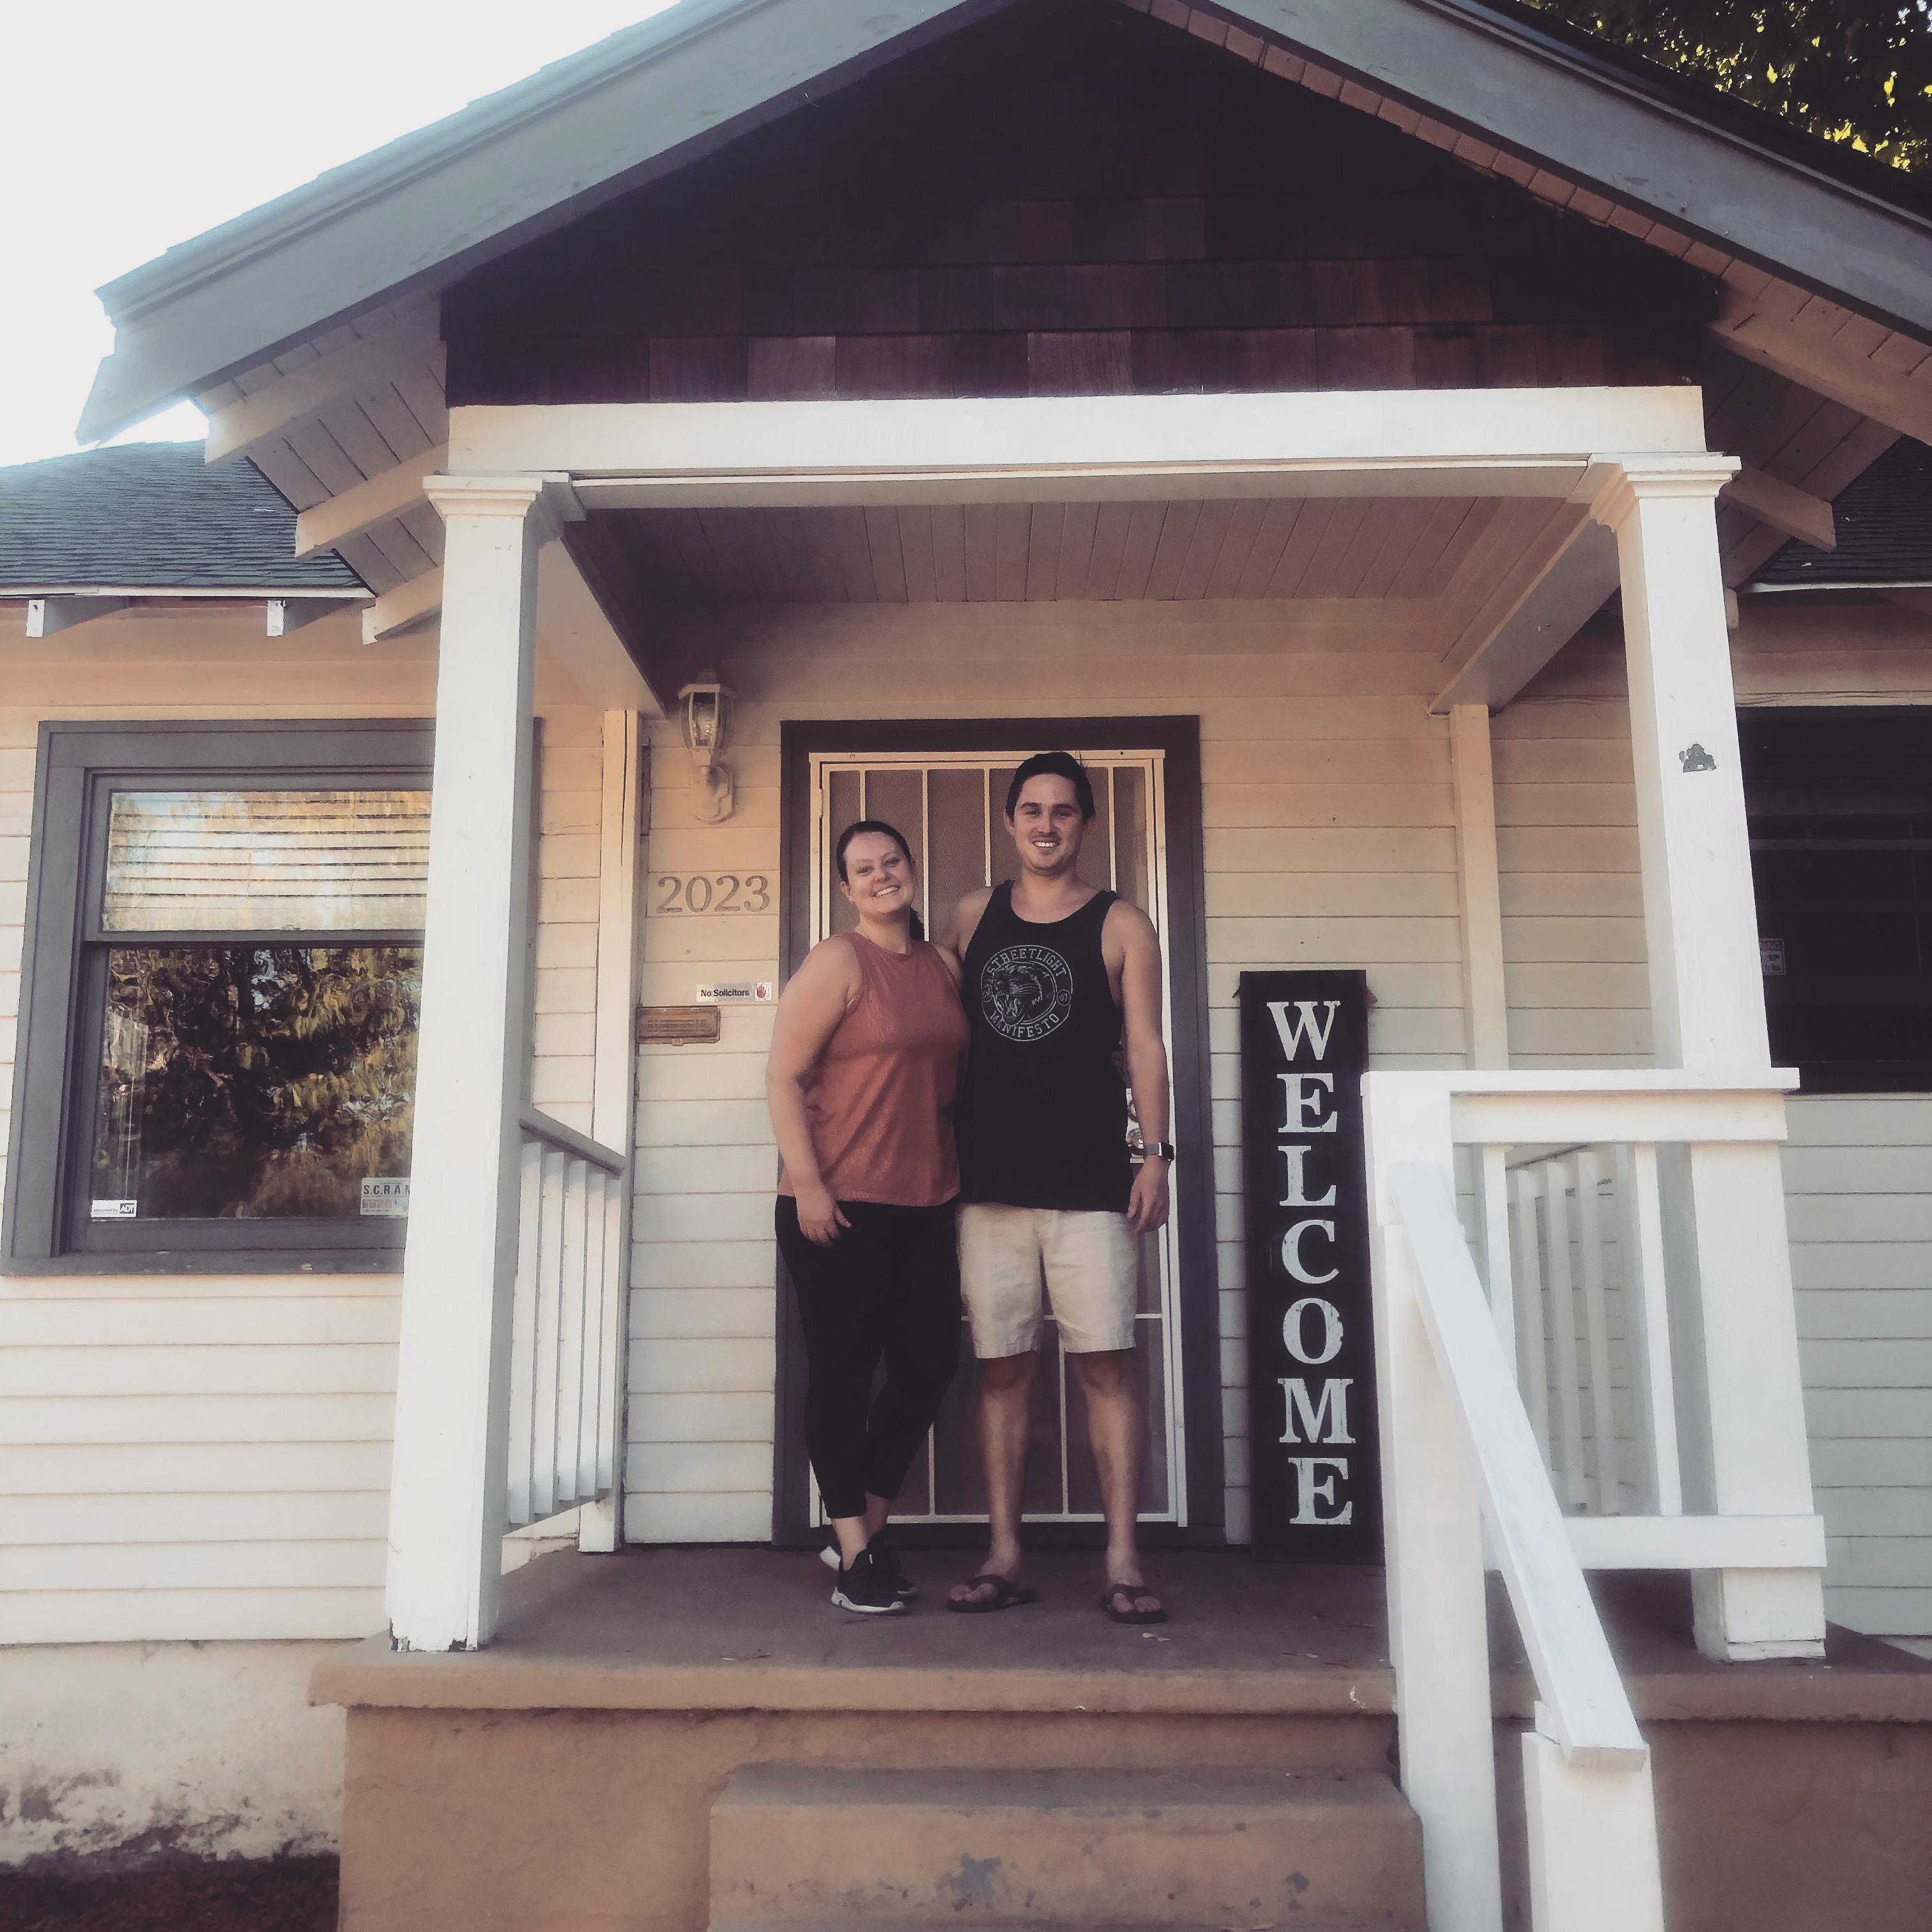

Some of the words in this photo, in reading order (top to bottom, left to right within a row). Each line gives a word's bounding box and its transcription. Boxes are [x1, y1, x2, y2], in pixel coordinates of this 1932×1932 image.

[657, 875, 770, 913] 2023
[987, 948, 1066, 977] STREETLIGHT
[990, 1010, 1059, 1037] MANIFESTO
[1266, 1000, 1356, 1525] WELCOME
